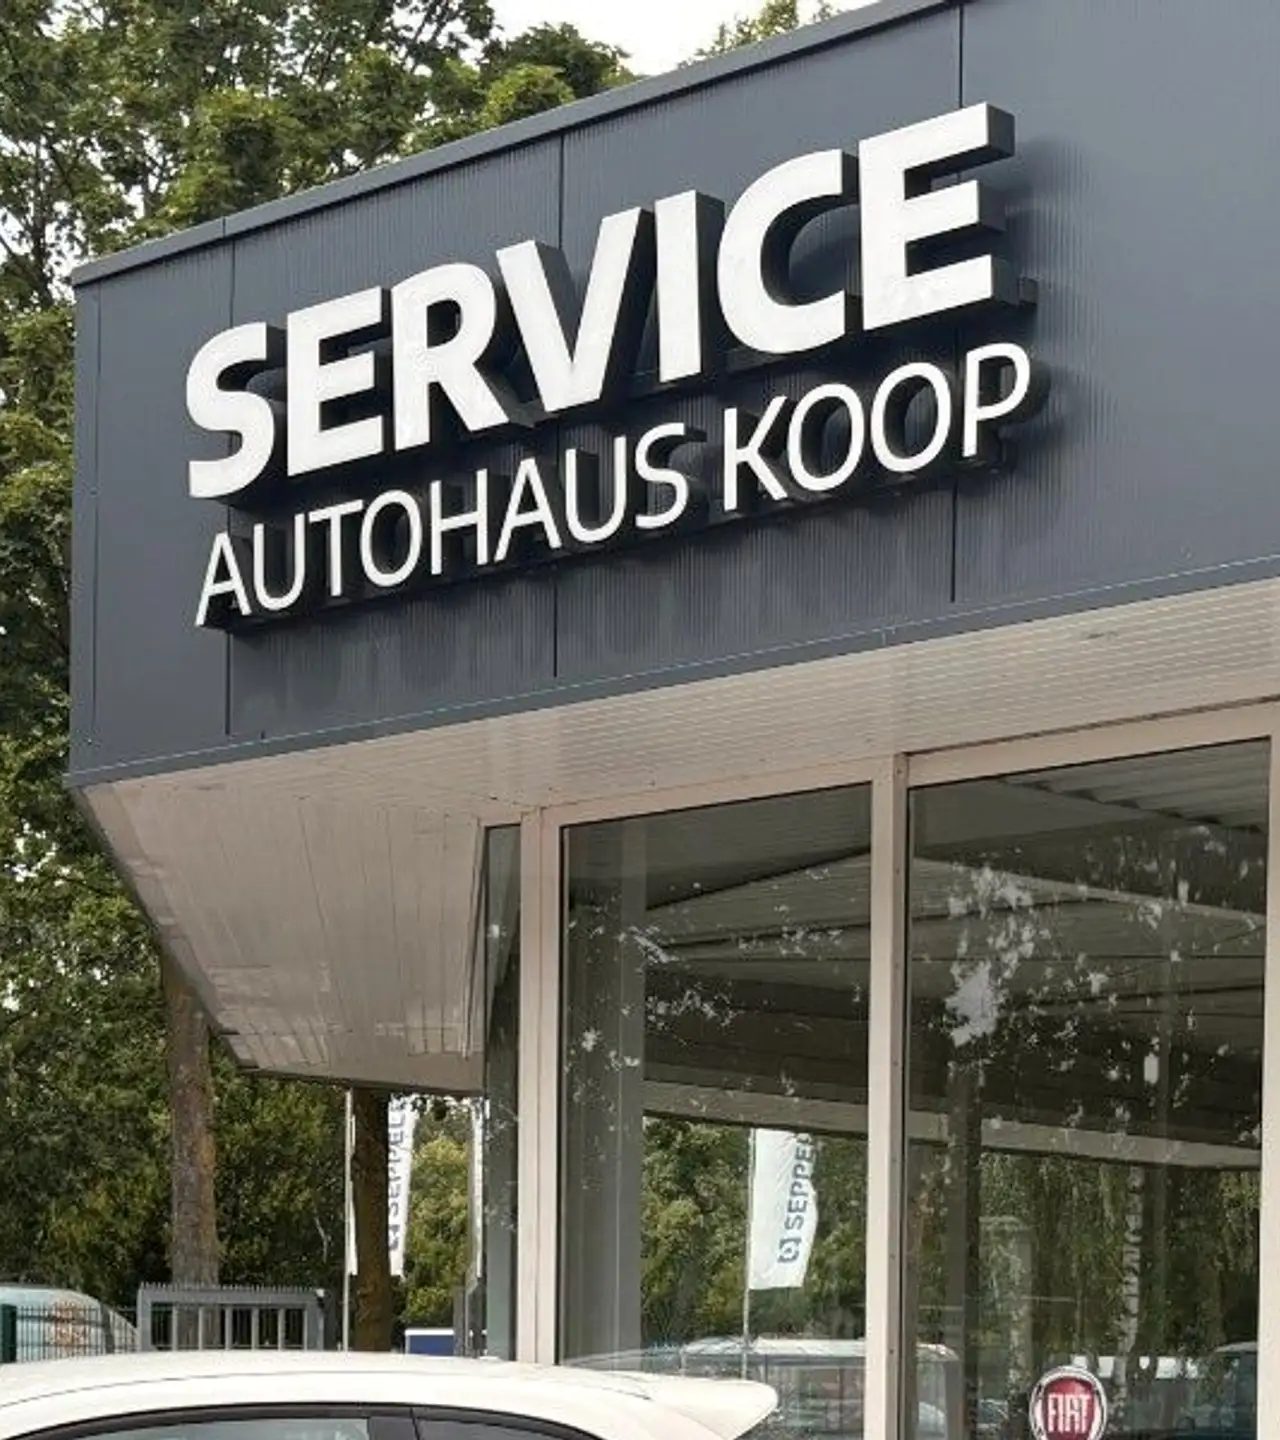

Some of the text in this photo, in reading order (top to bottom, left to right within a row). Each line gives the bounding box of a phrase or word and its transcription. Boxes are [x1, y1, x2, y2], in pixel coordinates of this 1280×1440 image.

[185, 102, 999, 499] SERVICE
[195, 341, 1031, 628] AUTOHAUS KOOP
[1047, 1393, 1092, 1433] FIAT
